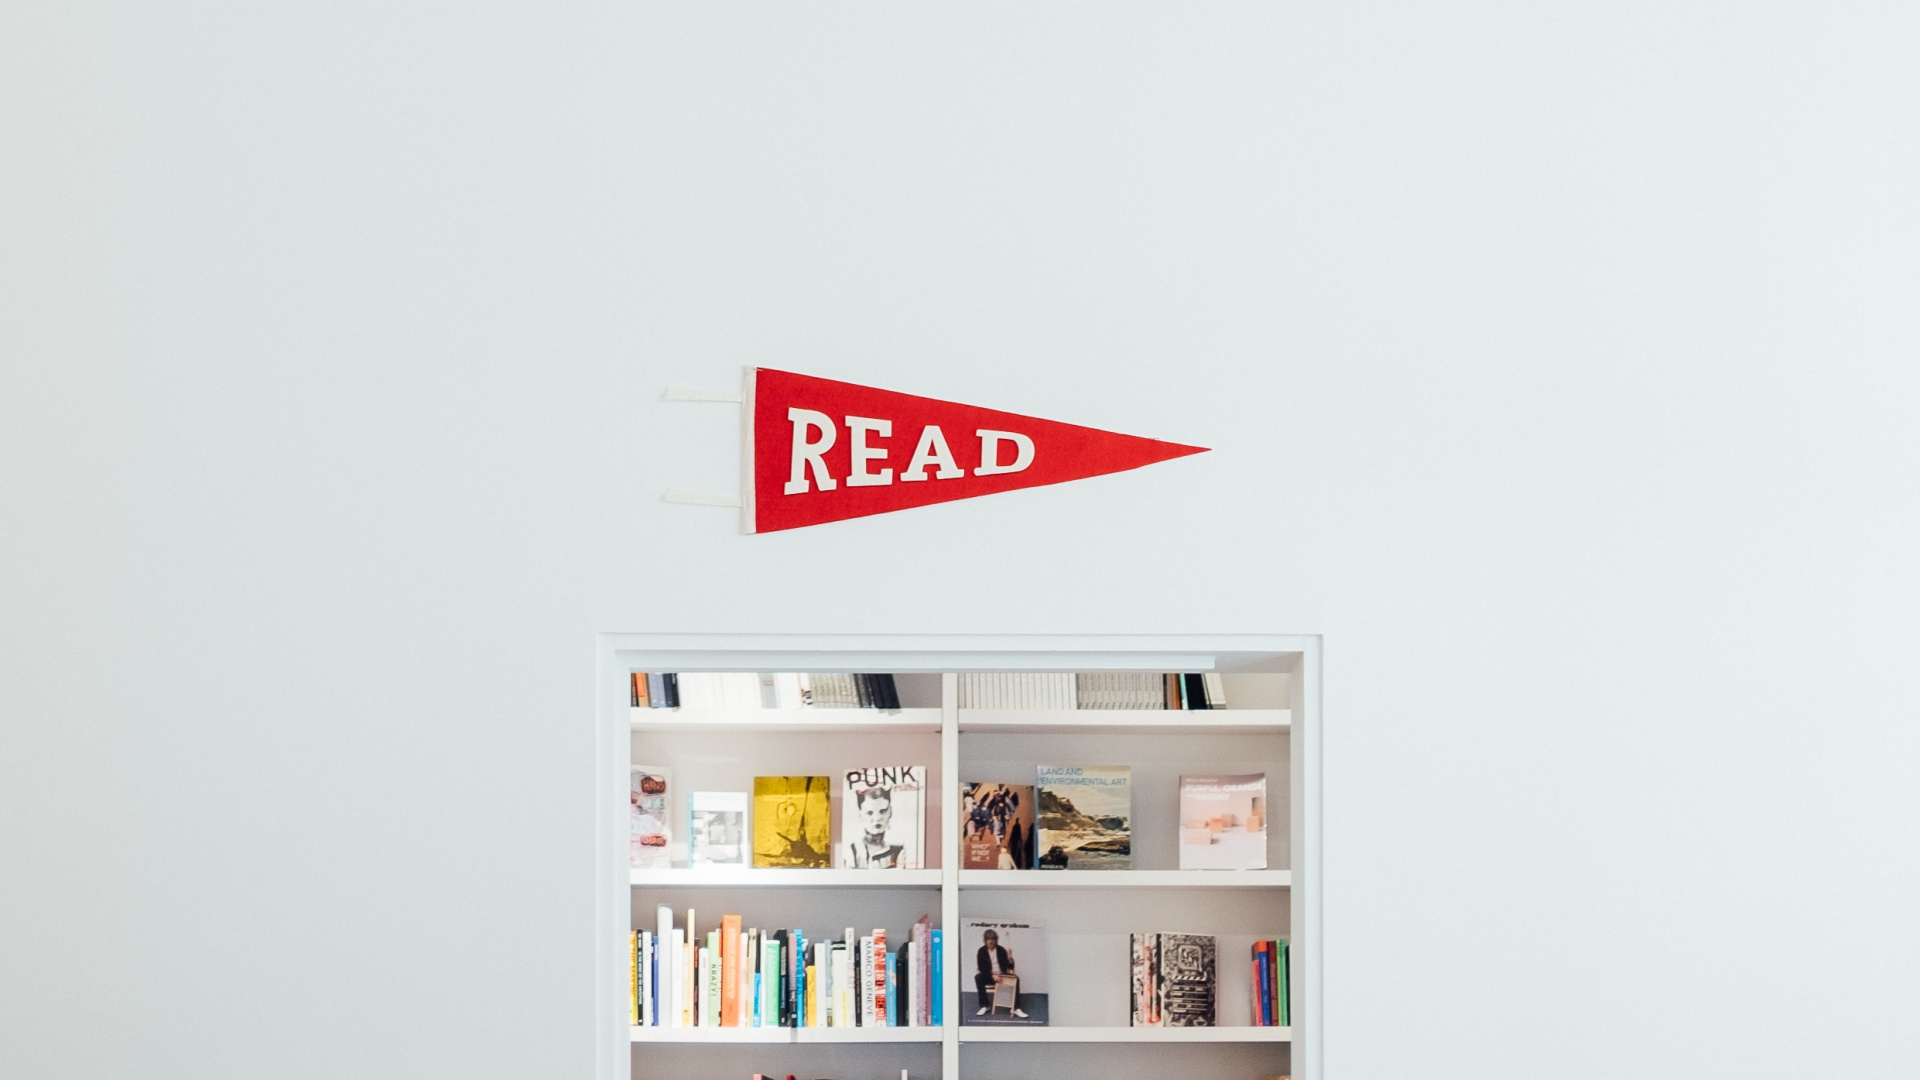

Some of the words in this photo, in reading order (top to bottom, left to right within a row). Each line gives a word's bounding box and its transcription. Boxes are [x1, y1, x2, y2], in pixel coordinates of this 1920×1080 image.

[784, 407, 1036, 495] READ
[847, 766, 916, 790] PUNK
[1041, 777, 1110, 785] ENVIRONMENTAL
[1111, 777, 1127, 785] ART
[865, 940, 873, 975] MAMCO
